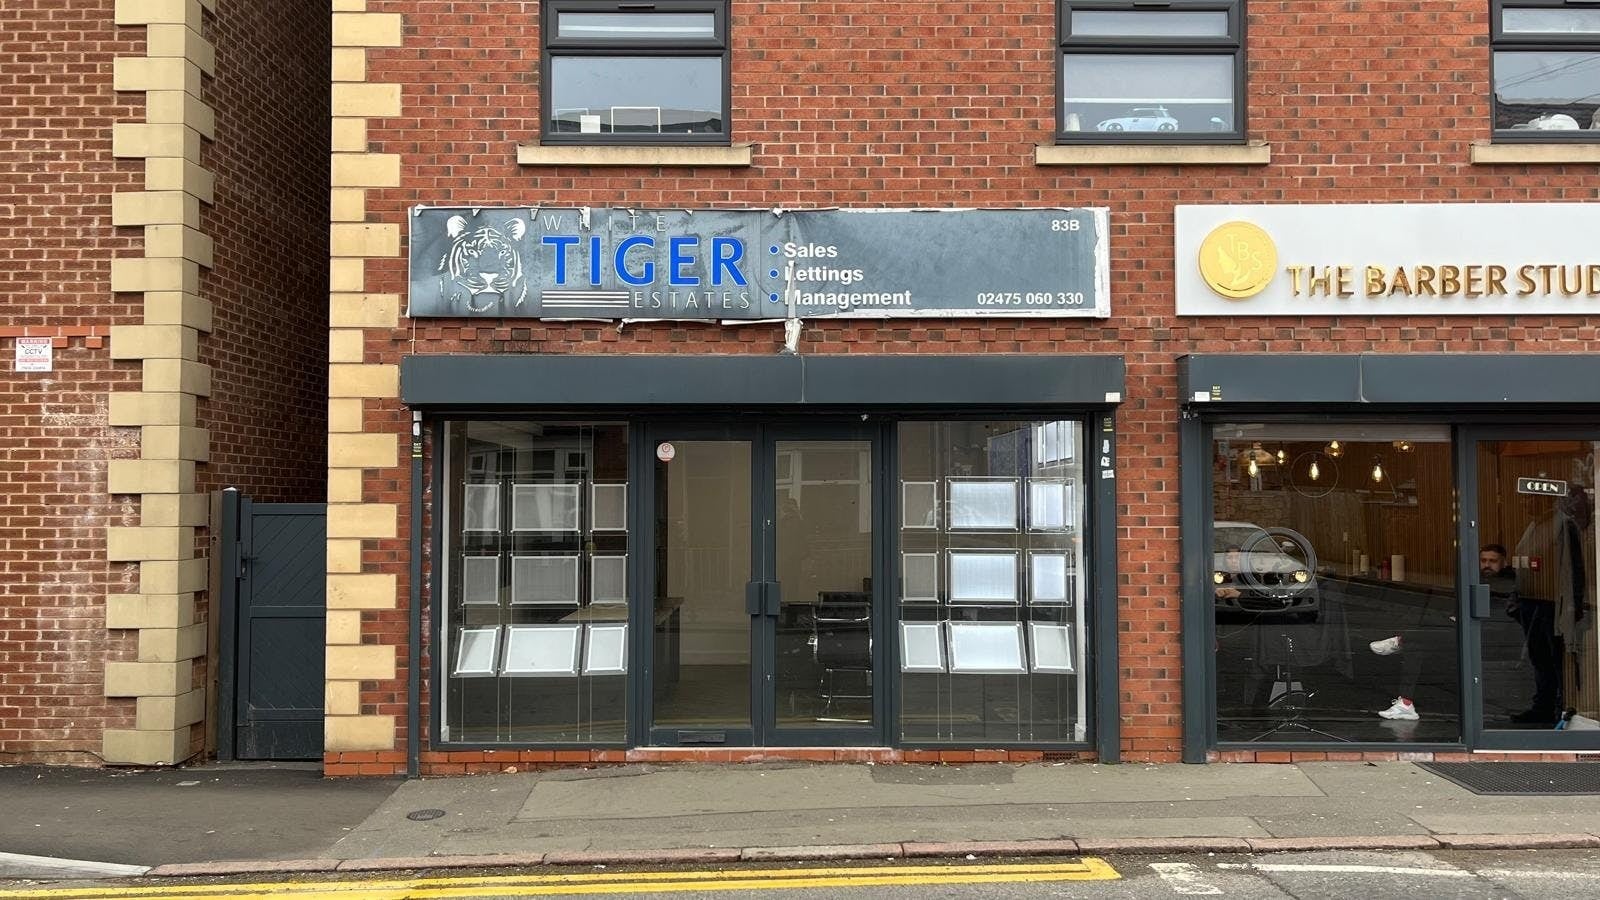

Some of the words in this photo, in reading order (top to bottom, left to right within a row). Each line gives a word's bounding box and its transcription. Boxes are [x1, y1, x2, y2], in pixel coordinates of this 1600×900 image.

[1051, 219, 1080, 231] 83B
[784, 242, 838, 258] Sales
[541, 235, 749, 287] TIGER
[1286, 264, 1354, 298] THE
[1365, 264, 1508, 298] BARBER
[634, 291, 750, 308] ESTATES
[977, 292, 1021, 305] 02475
[1025, 292, 1052, 305] 060
[1057, 292, 1084, 305] 330
[1526, 481, 1559, 492] OPEN
